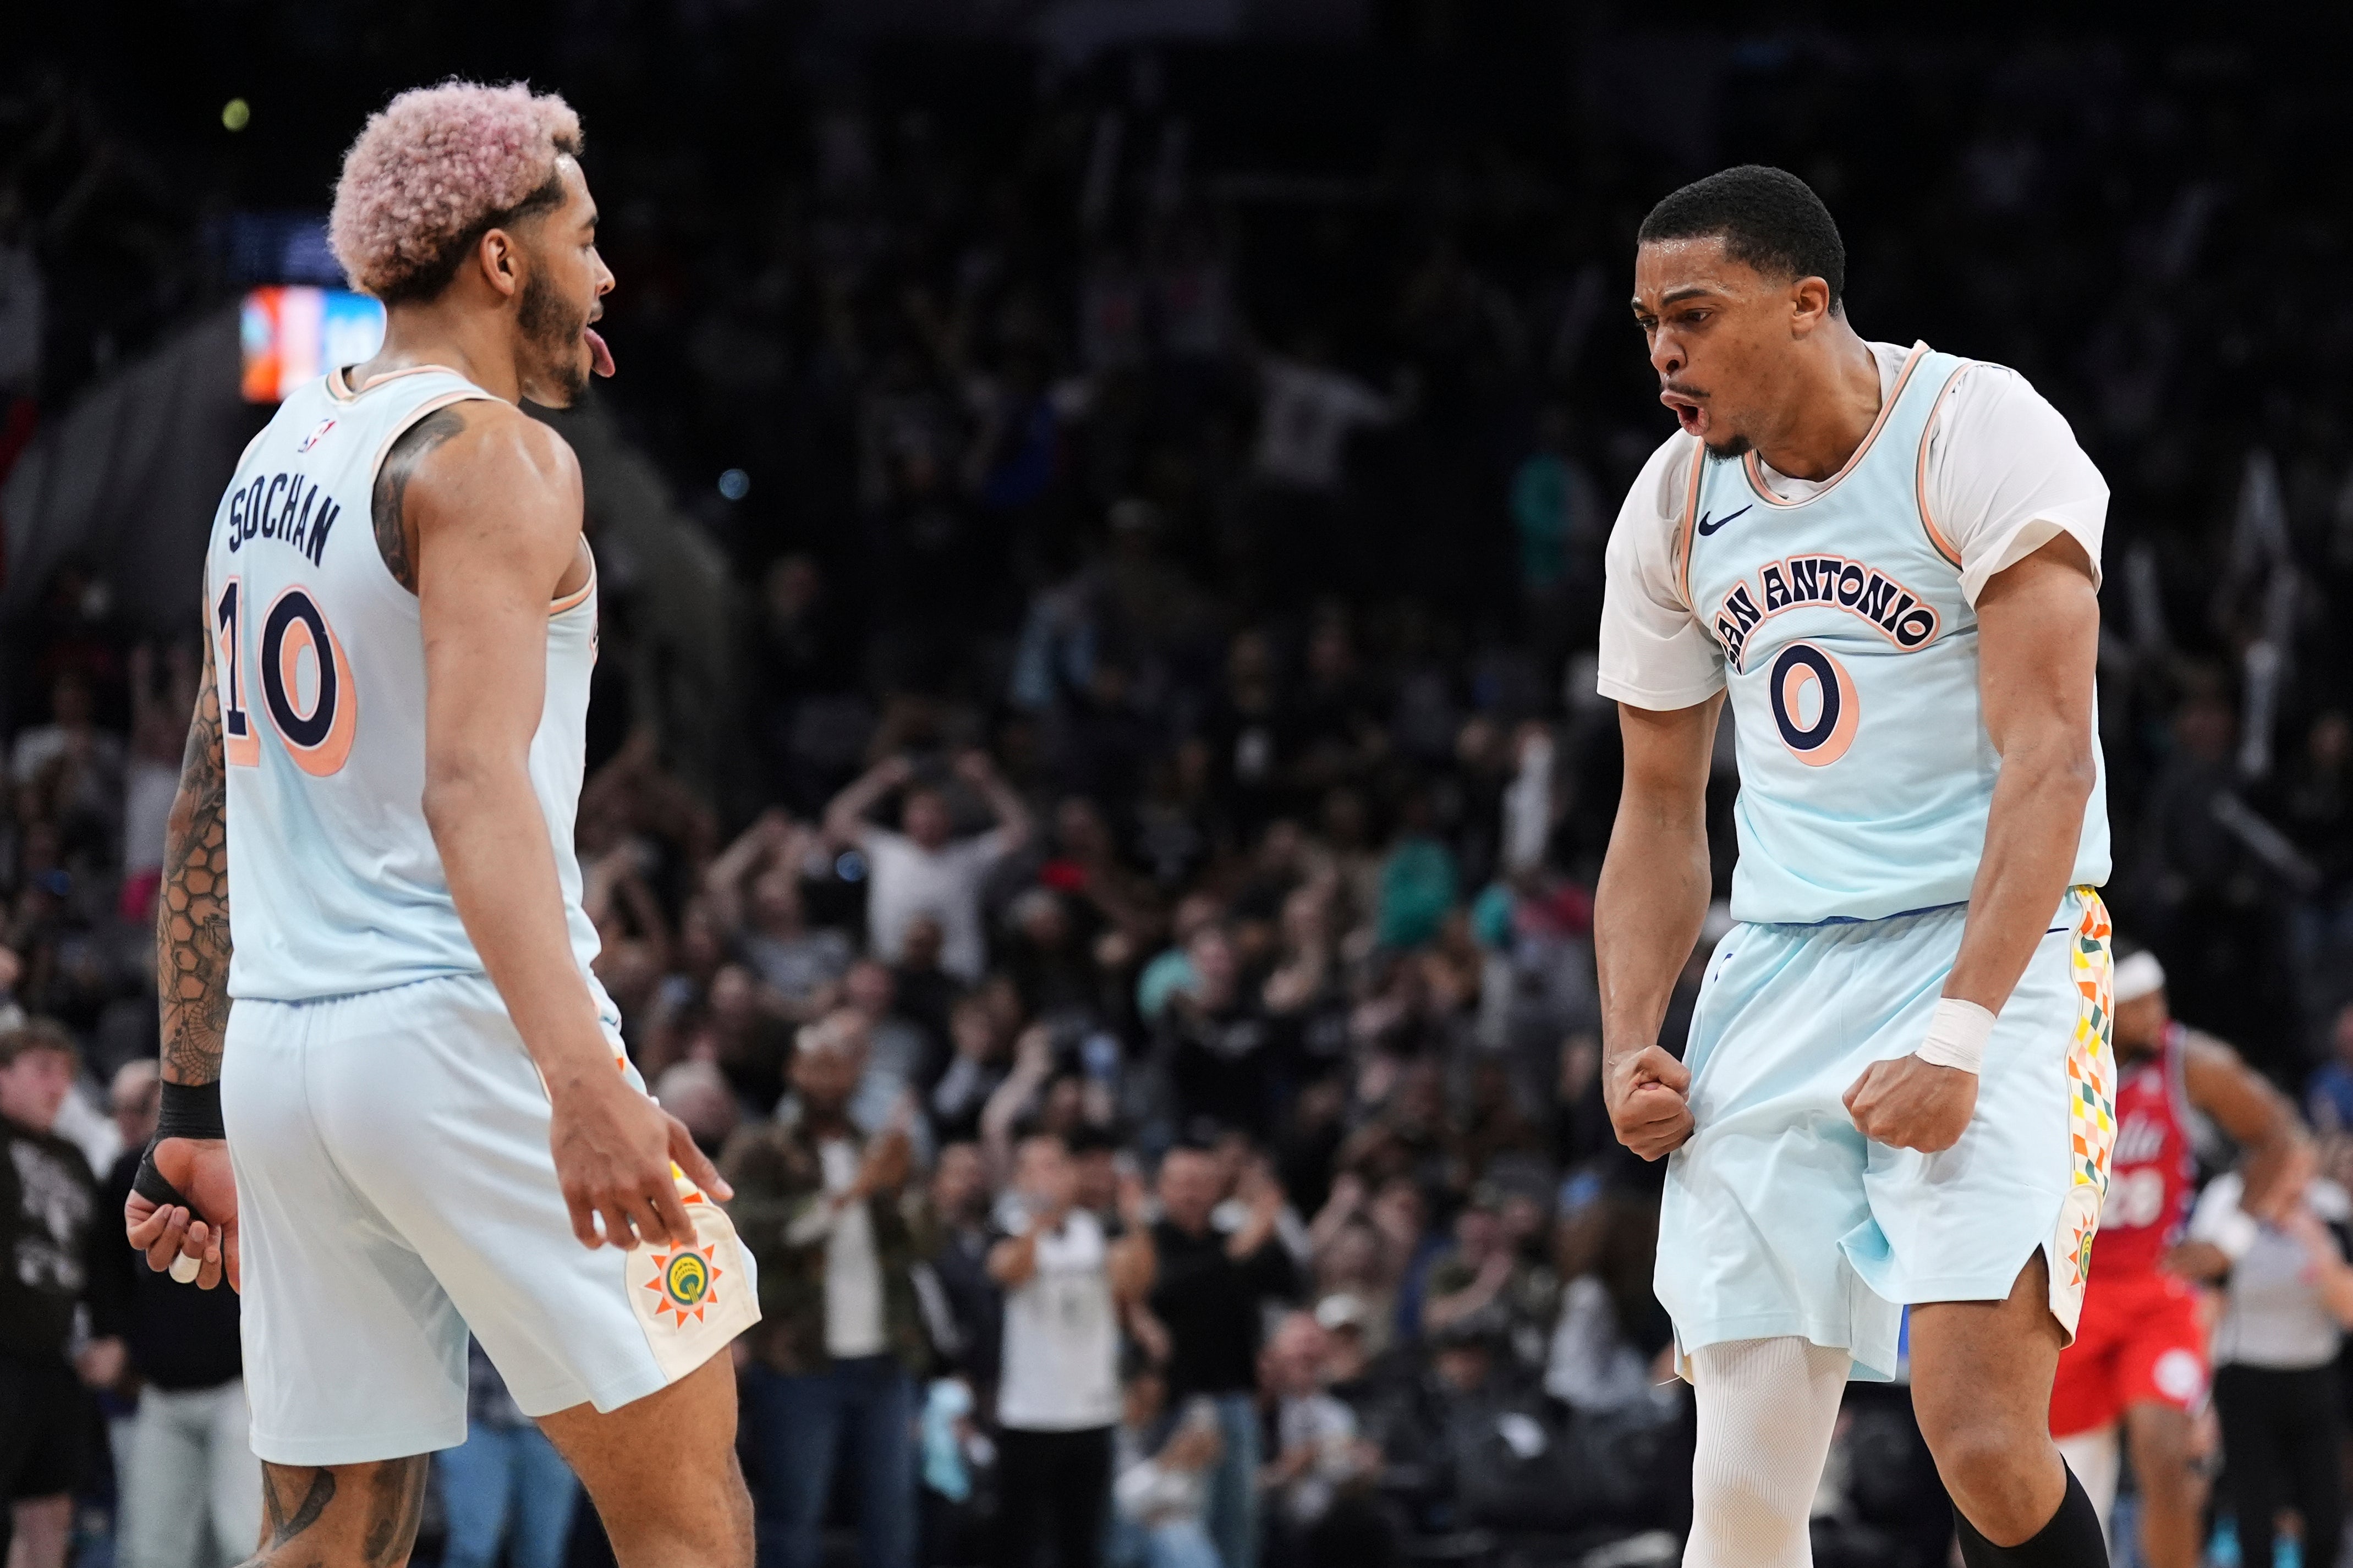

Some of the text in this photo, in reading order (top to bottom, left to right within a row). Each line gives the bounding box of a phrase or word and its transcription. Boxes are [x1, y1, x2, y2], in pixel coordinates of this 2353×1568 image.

[229, 472, 340, 568] SOCHAN
[1759, 554, 1940, 651] ANTONIO
[218, 576, 356, 777] 10
[1768, 642, 1859, 767] 0
